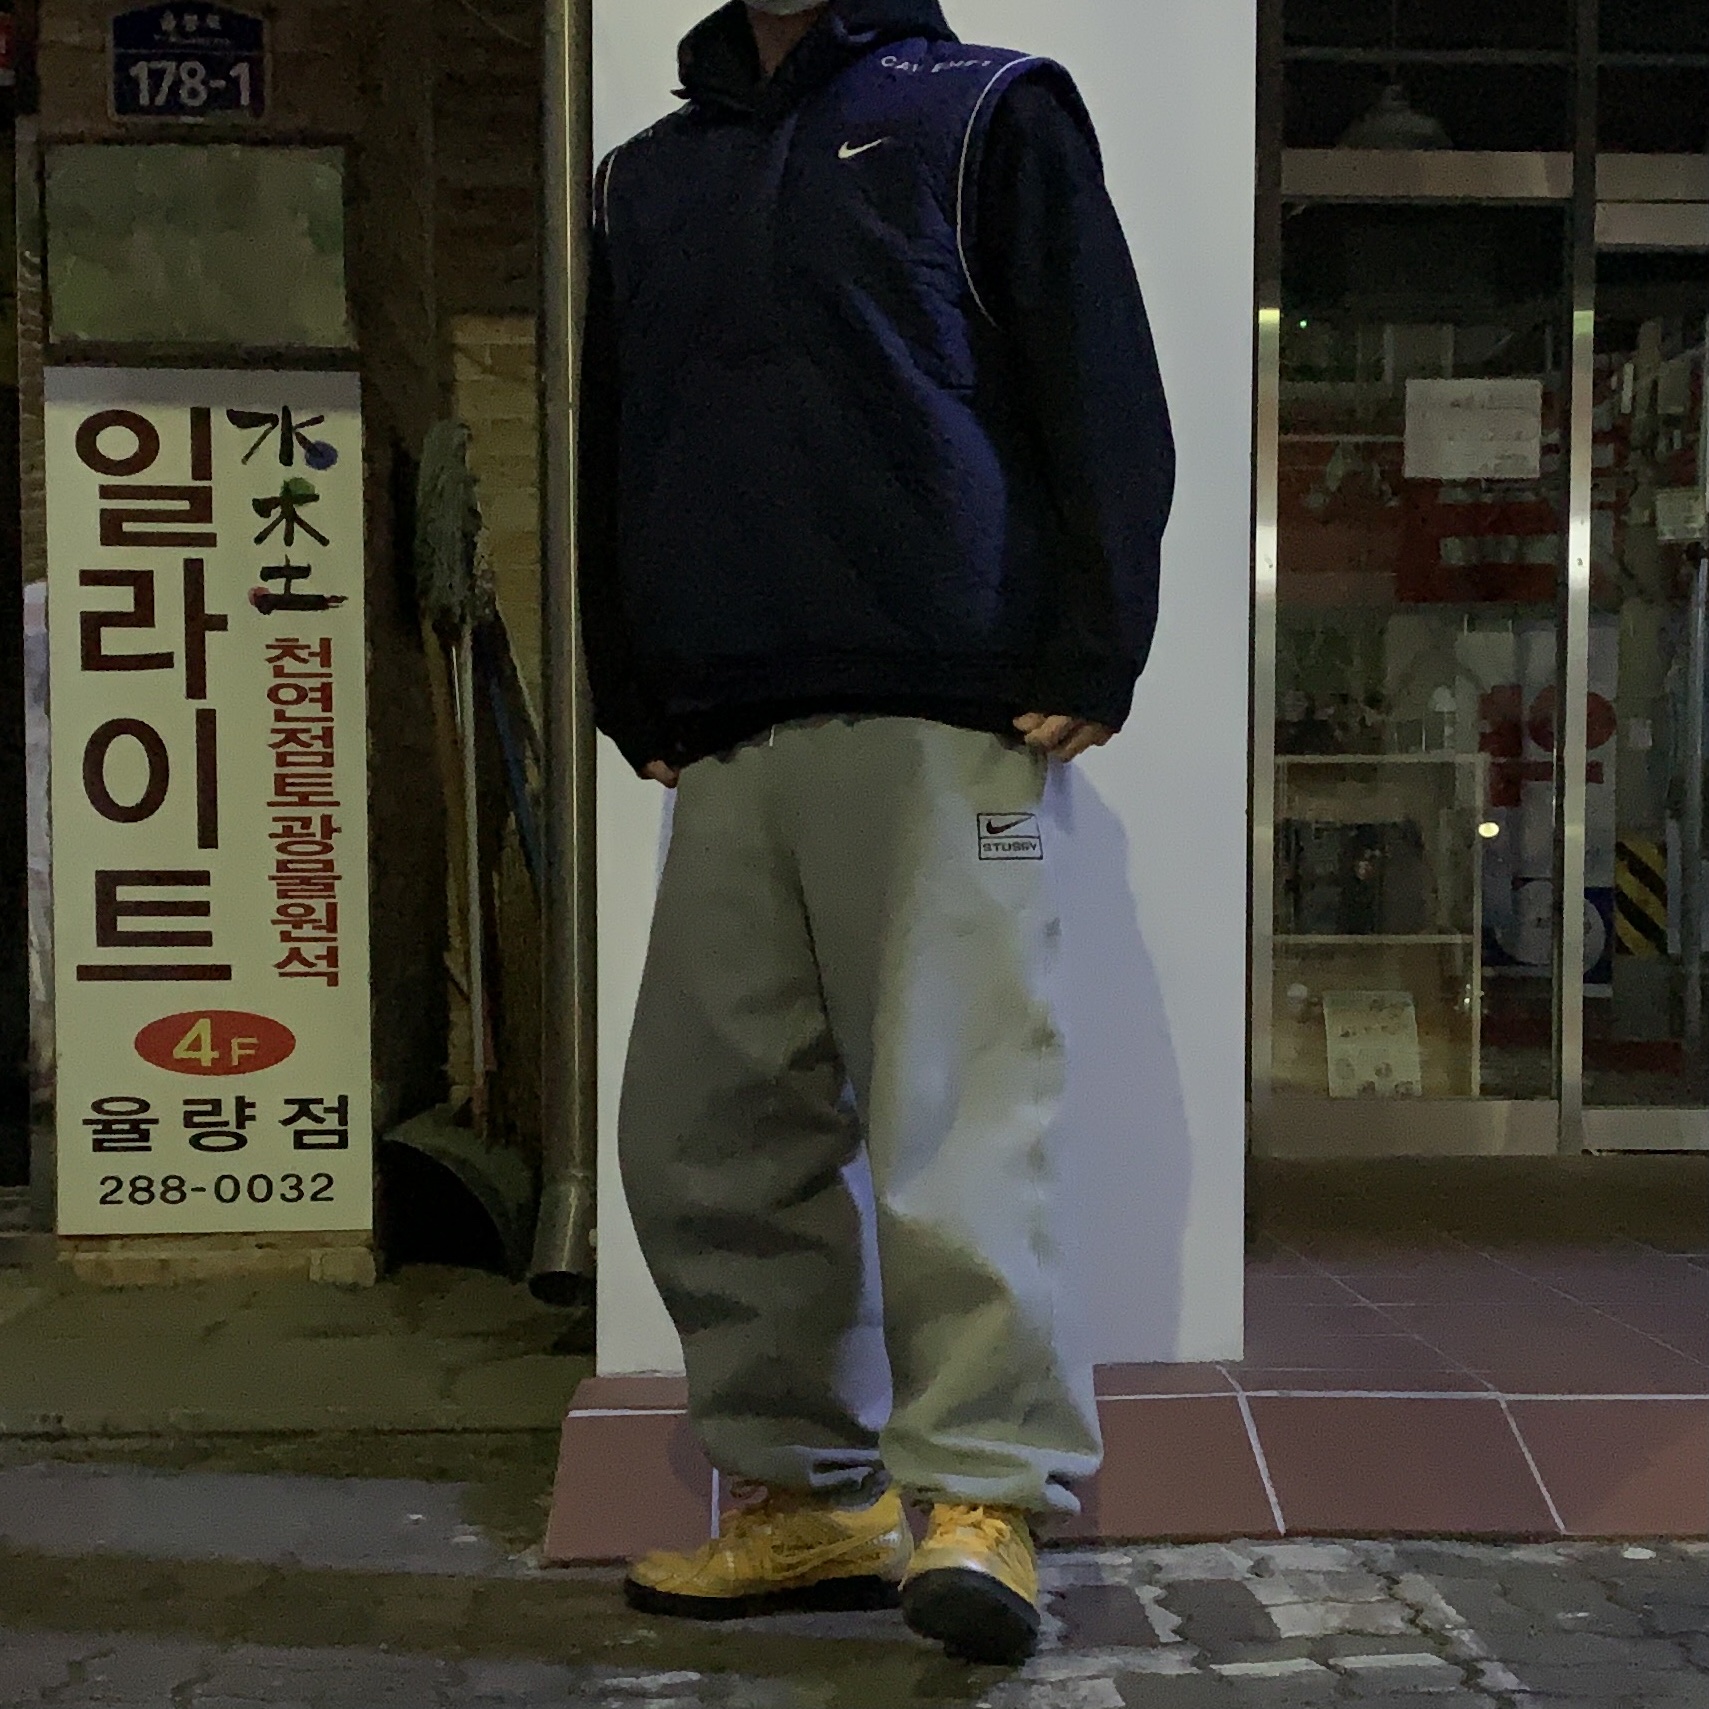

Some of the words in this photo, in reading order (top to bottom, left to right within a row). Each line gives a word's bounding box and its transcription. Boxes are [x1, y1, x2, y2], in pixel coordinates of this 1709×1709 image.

[128, 60, 251, 107] 178-1
[75, 406, 232, 982] 일라이트
[99, 1172, 335, 1205] 288-0032
